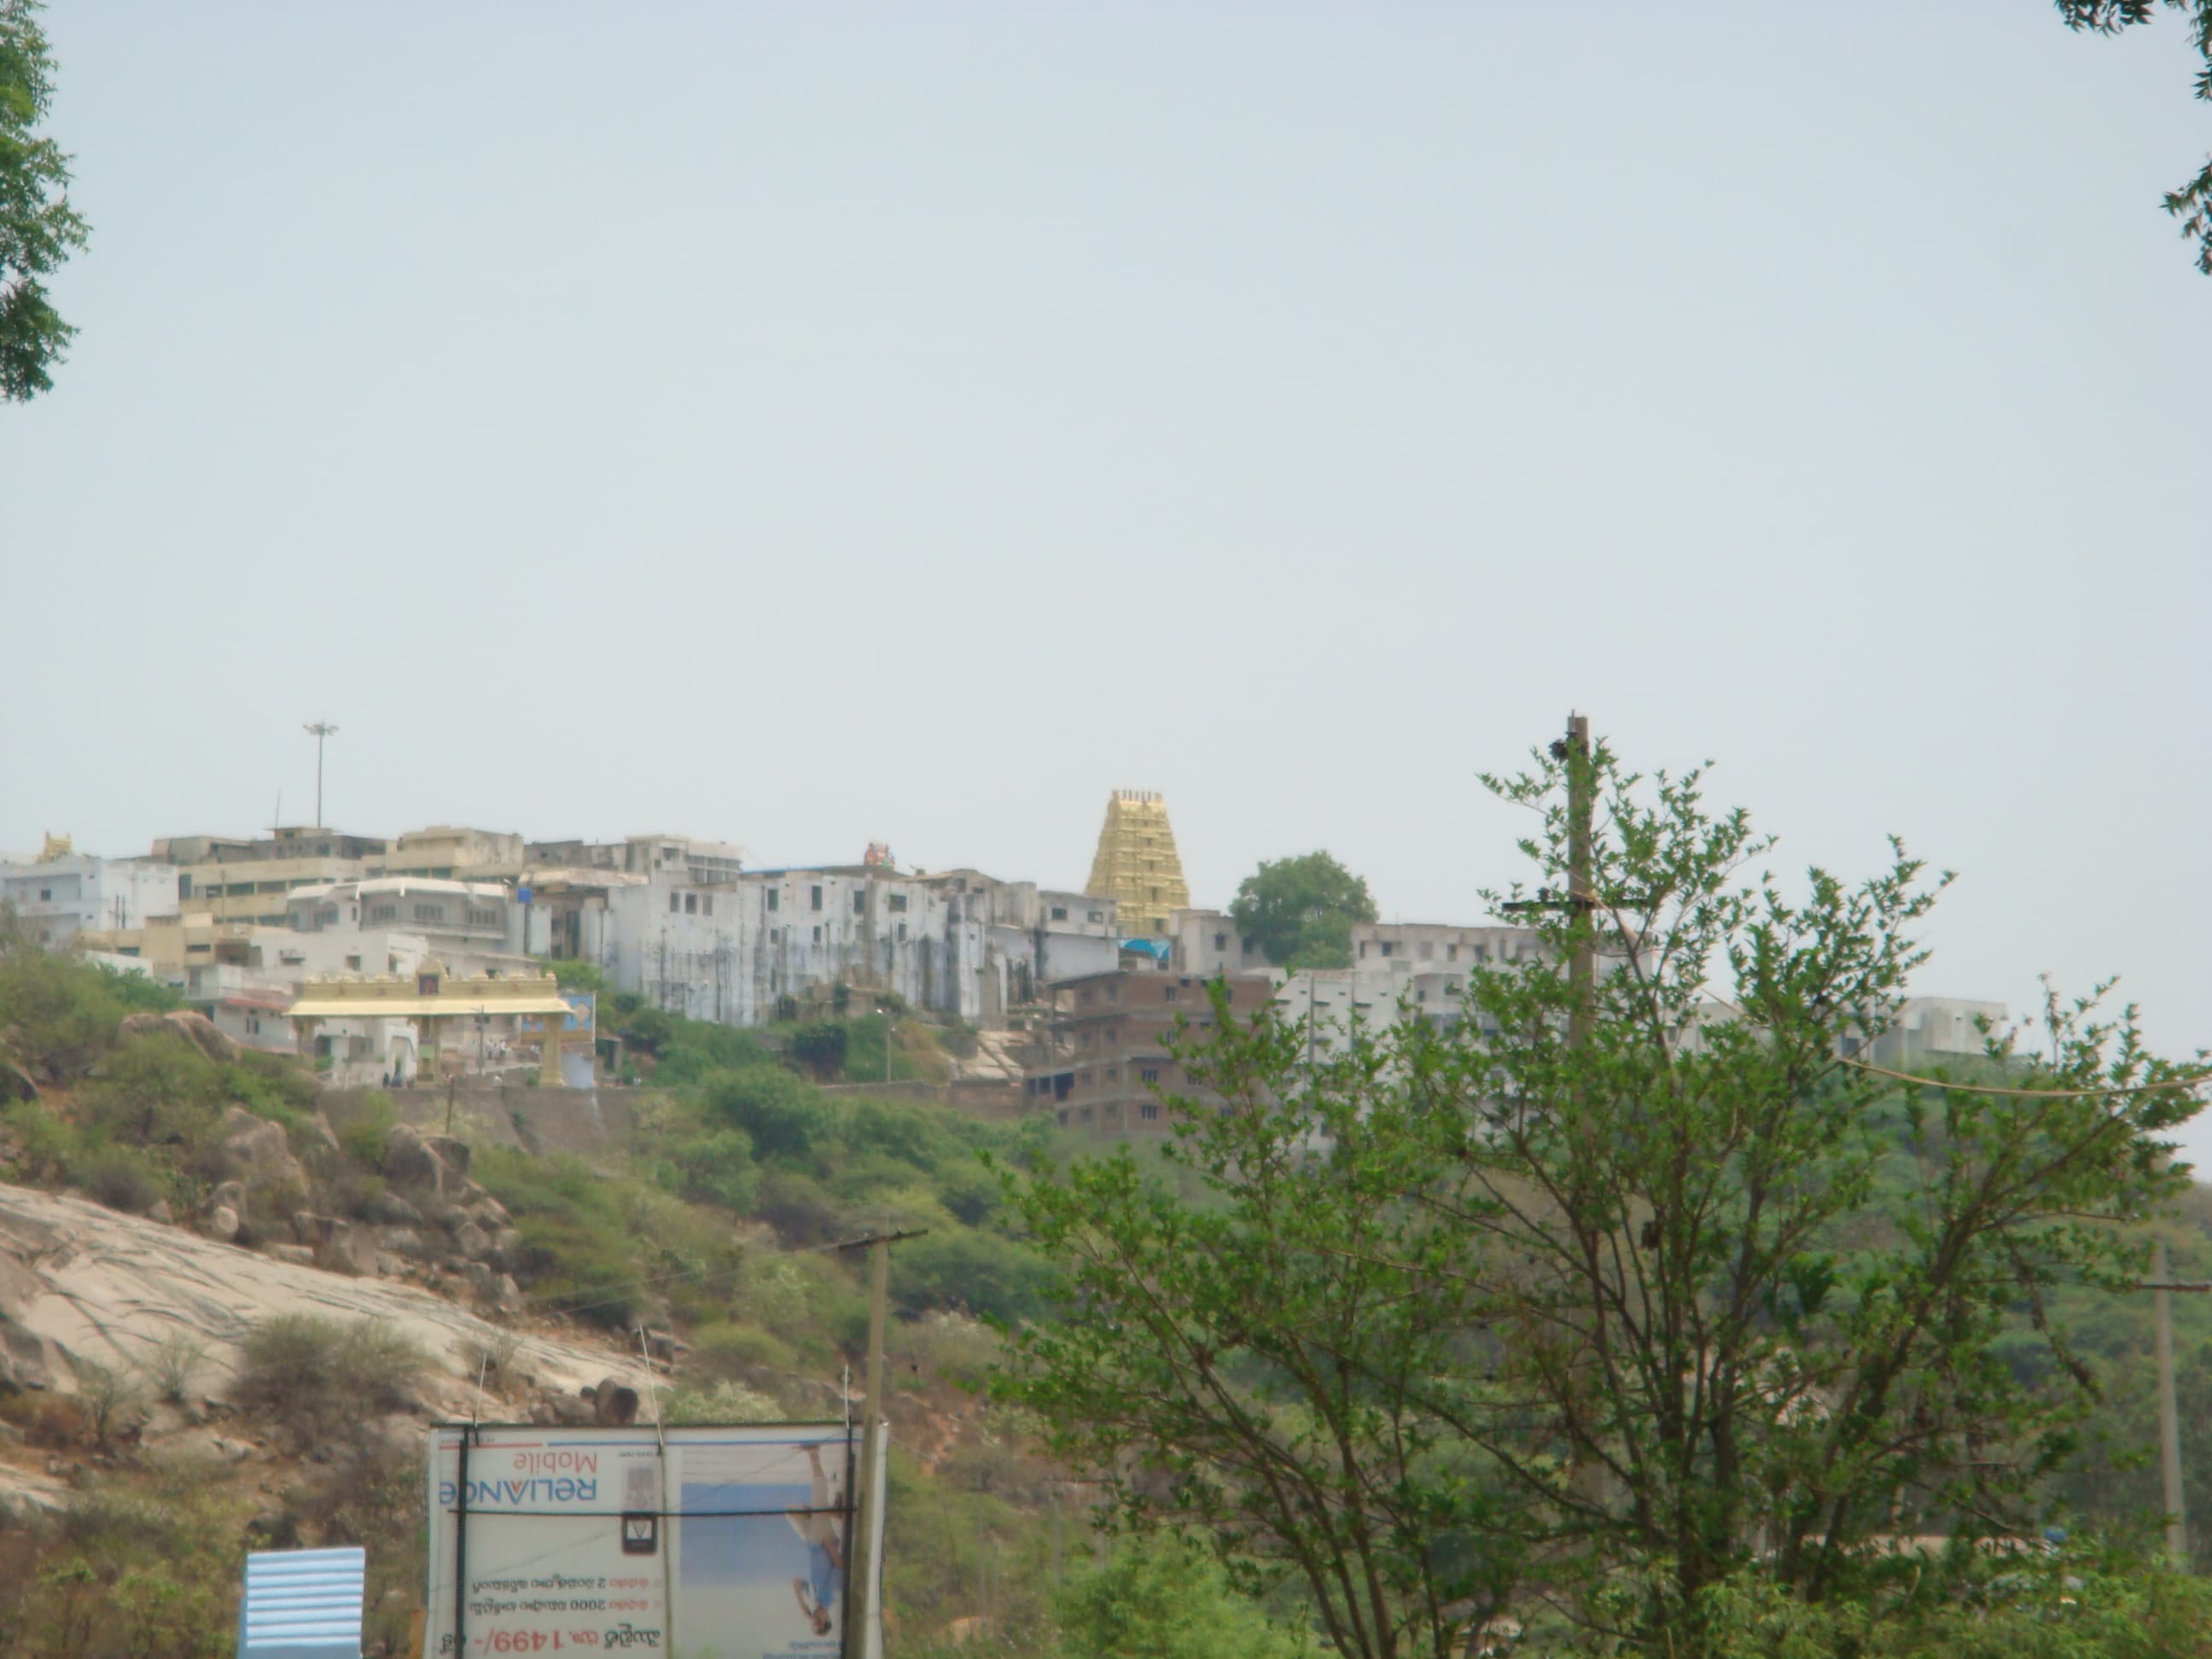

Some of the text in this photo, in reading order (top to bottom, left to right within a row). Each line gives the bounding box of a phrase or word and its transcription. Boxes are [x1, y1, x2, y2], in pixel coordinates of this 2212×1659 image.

[514, 1452, 597, 1476] Mobile
[598, 1577, 606, 1588] 2
[570, 1598, 606, 1610] 2000
[474, 1628, 565, 1656] 1499/-
[604, 1622, 661, 1649] మొబైల్
